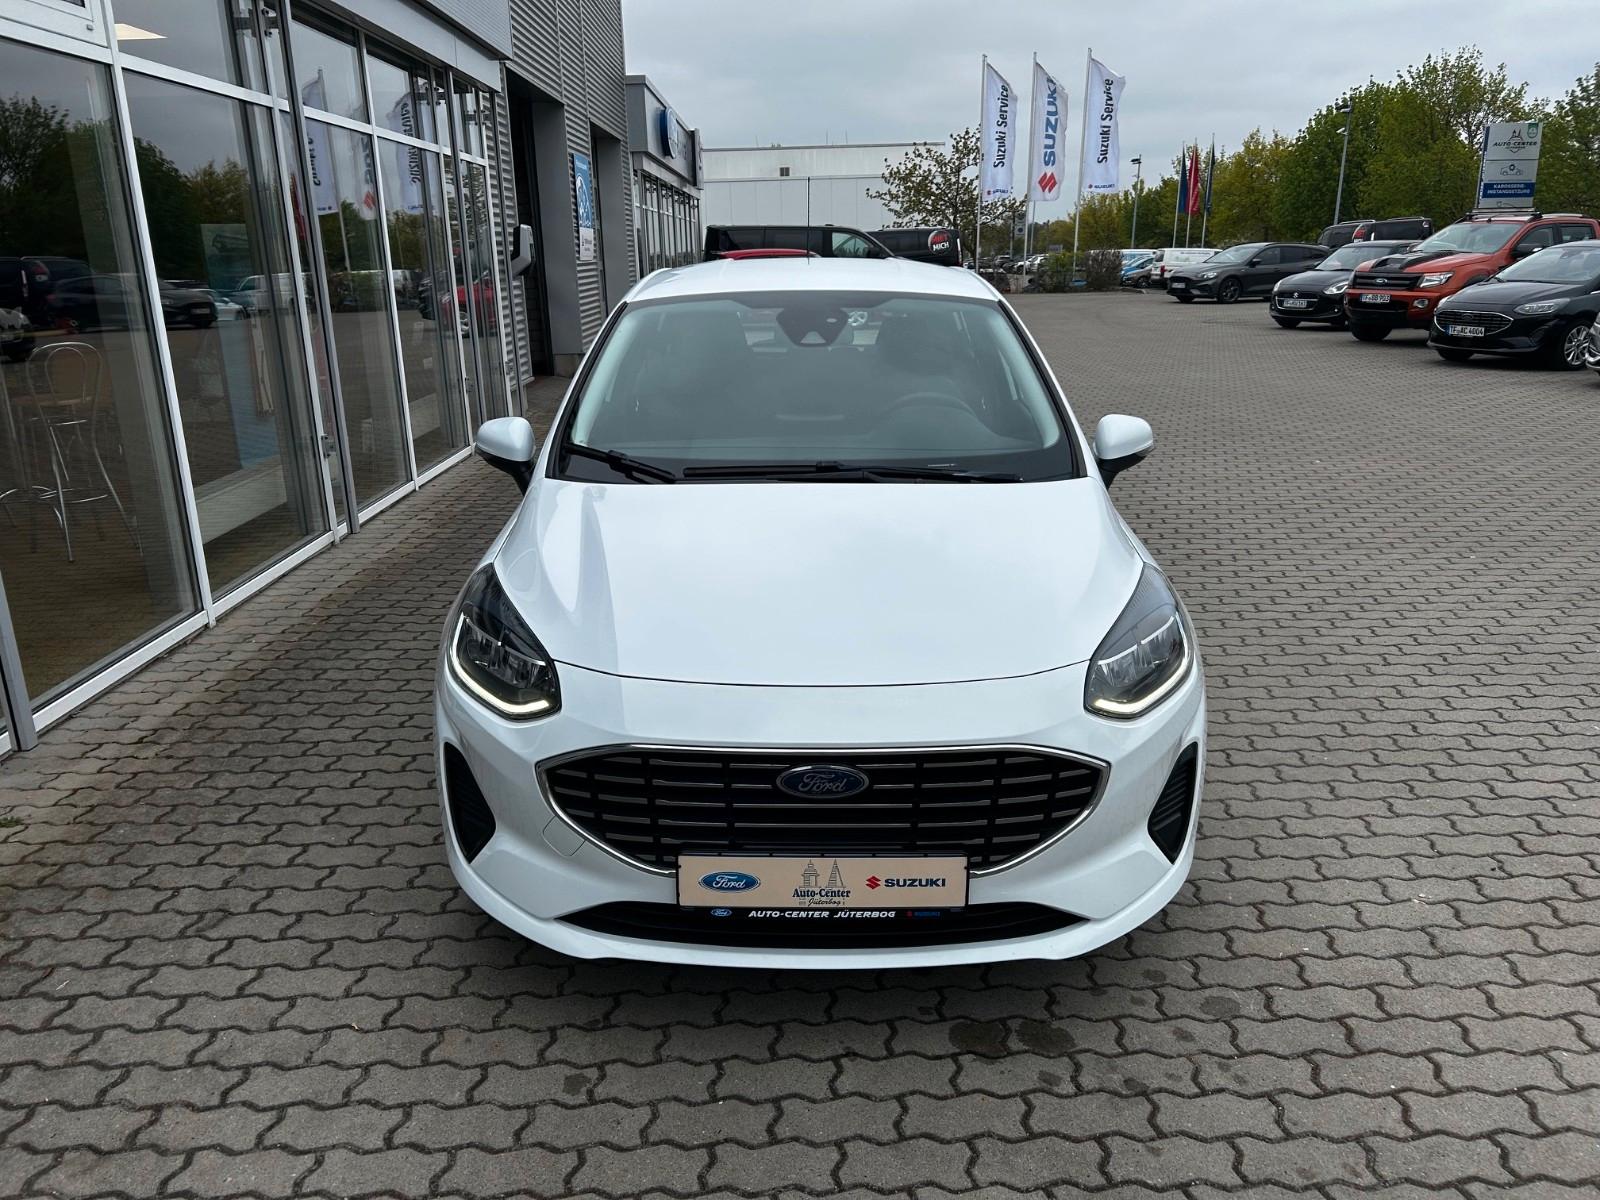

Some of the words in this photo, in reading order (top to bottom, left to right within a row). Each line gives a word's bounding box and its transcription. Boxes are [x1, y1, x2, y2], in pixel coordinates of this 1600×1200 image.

[997, 84, 1009, 128] Service
[1101, 78, 1114, 122] Service
[1043, 76, 1058, 167] SUZUKI
[993, 130, 1007, 168] Suzuki
[1097, 125, 1111, 164] Suzuki
[932, 241, 950, 252] MICH
[798, 772, 848, 792] Ford
[712, 874, 746, 889] Ford
[884, 878, 946, 887] SUZUKI
[792, 888, 851, 898] Auto-Center
[748, 910, 829, 918] AUTO-CENTER
[833, 908, 896, 918] JÜTERBOG
